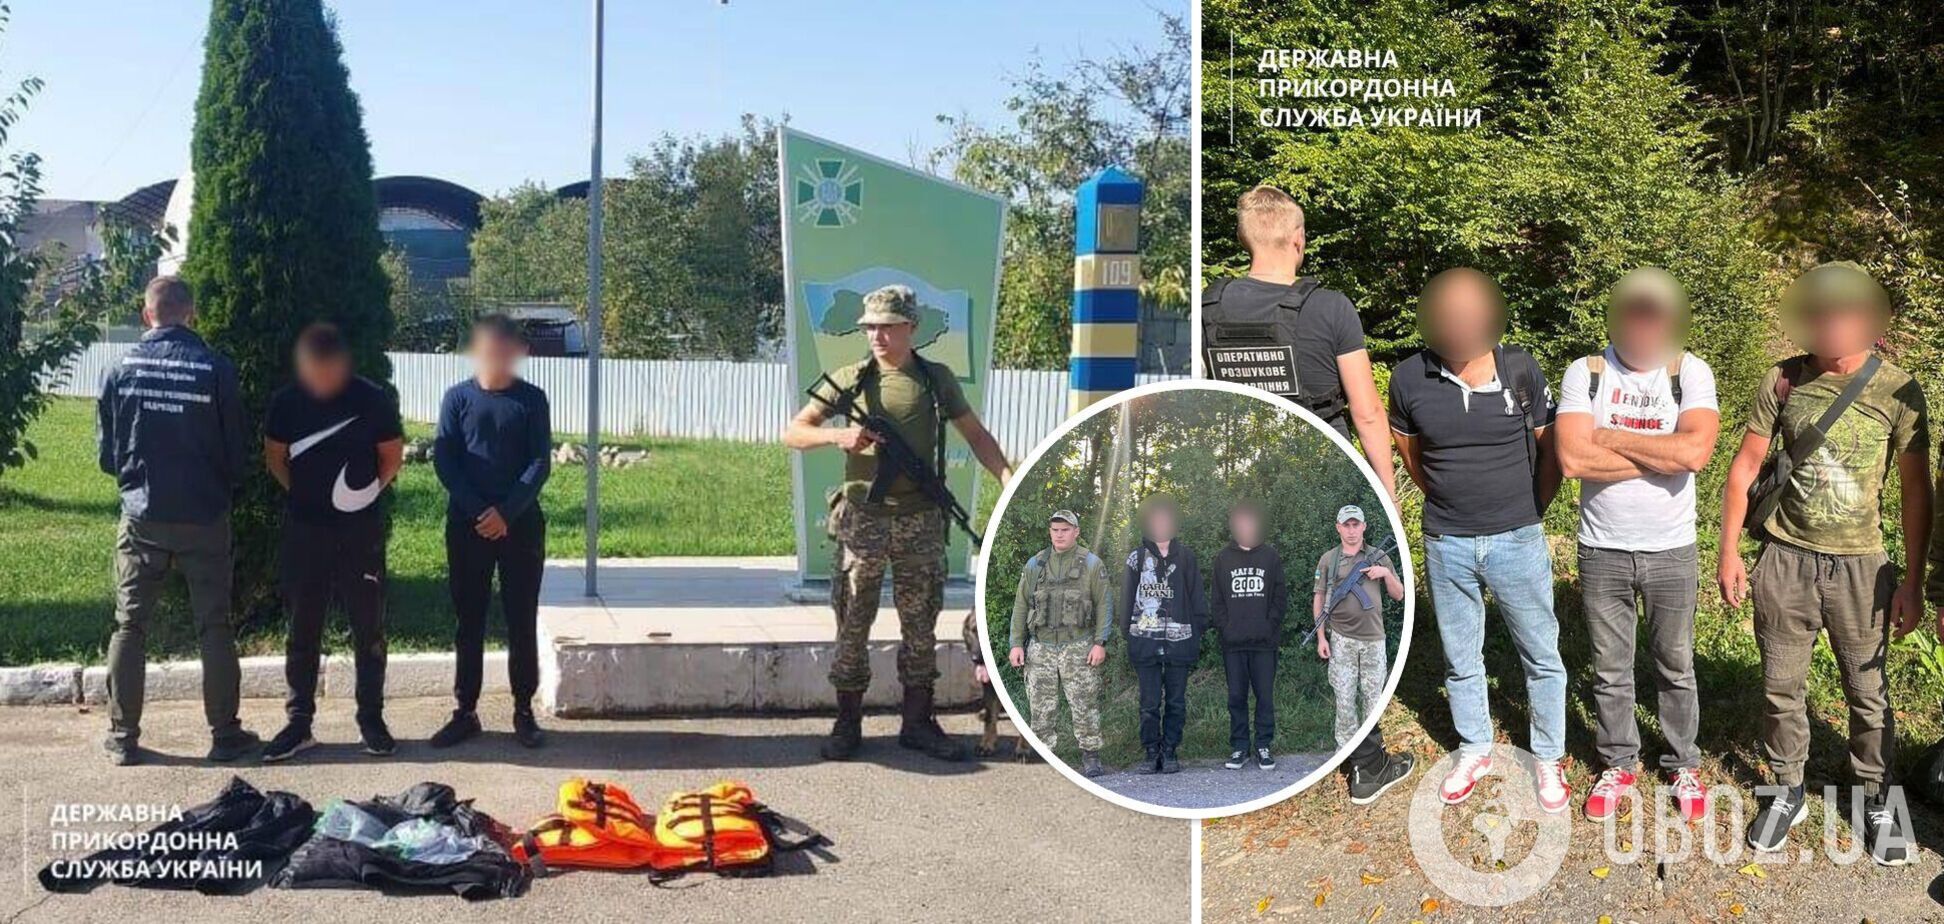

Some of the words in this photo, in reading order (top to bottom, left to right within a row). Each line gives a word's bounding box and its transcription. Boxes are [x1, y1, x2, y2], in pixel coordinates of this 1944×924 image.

[1103, 261, 1131, 285] 109
[1216, 351, 1285, 362] ОПЕРАТИВНО
[1221, 366, 1287, 377] РОЗШУКОВЕ
[1234, 578, 1262, 590] 2001
